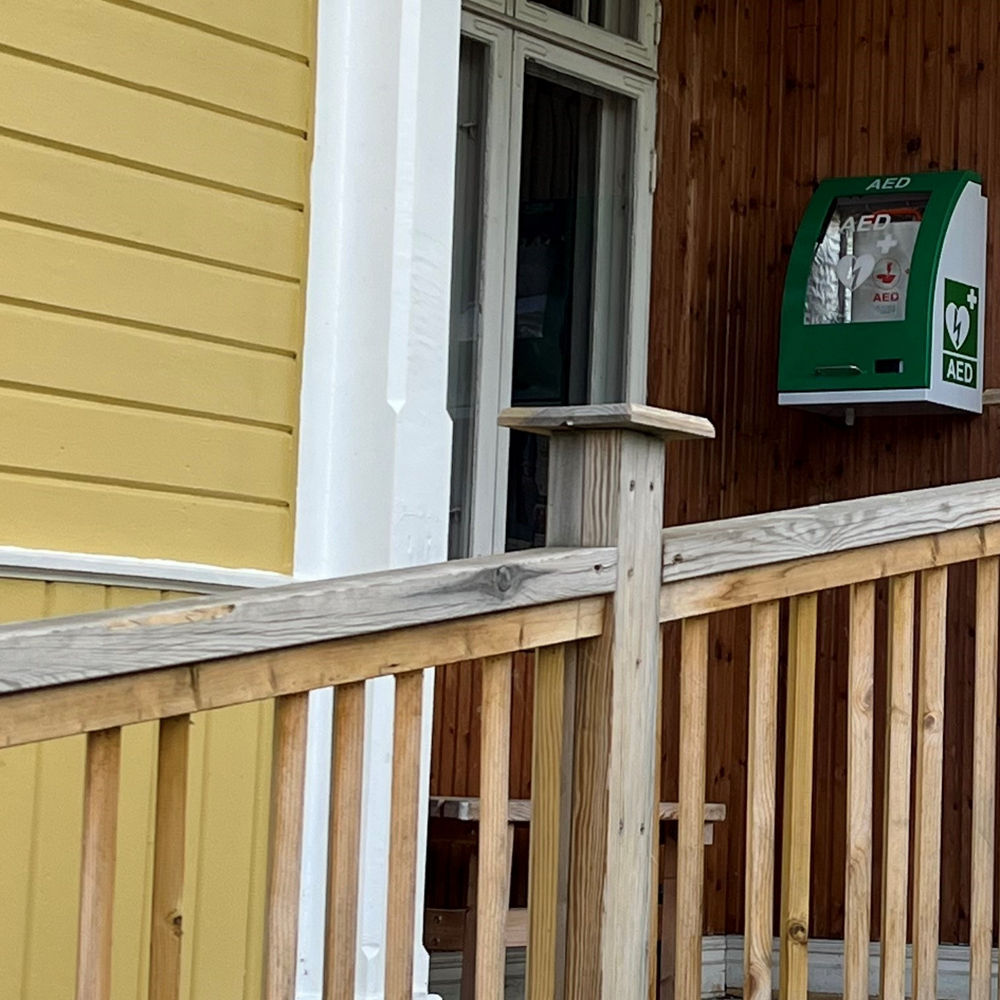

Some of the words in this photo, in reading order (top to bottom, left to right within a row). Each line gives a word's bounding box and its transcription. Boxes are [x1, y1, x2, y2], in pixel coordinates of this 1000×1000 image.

[865, 177, 911, 191] AED
[840, 213, 891, 233] AED
[873, 292, 899, 302] AED
[946, 358, 973, 383] AED
